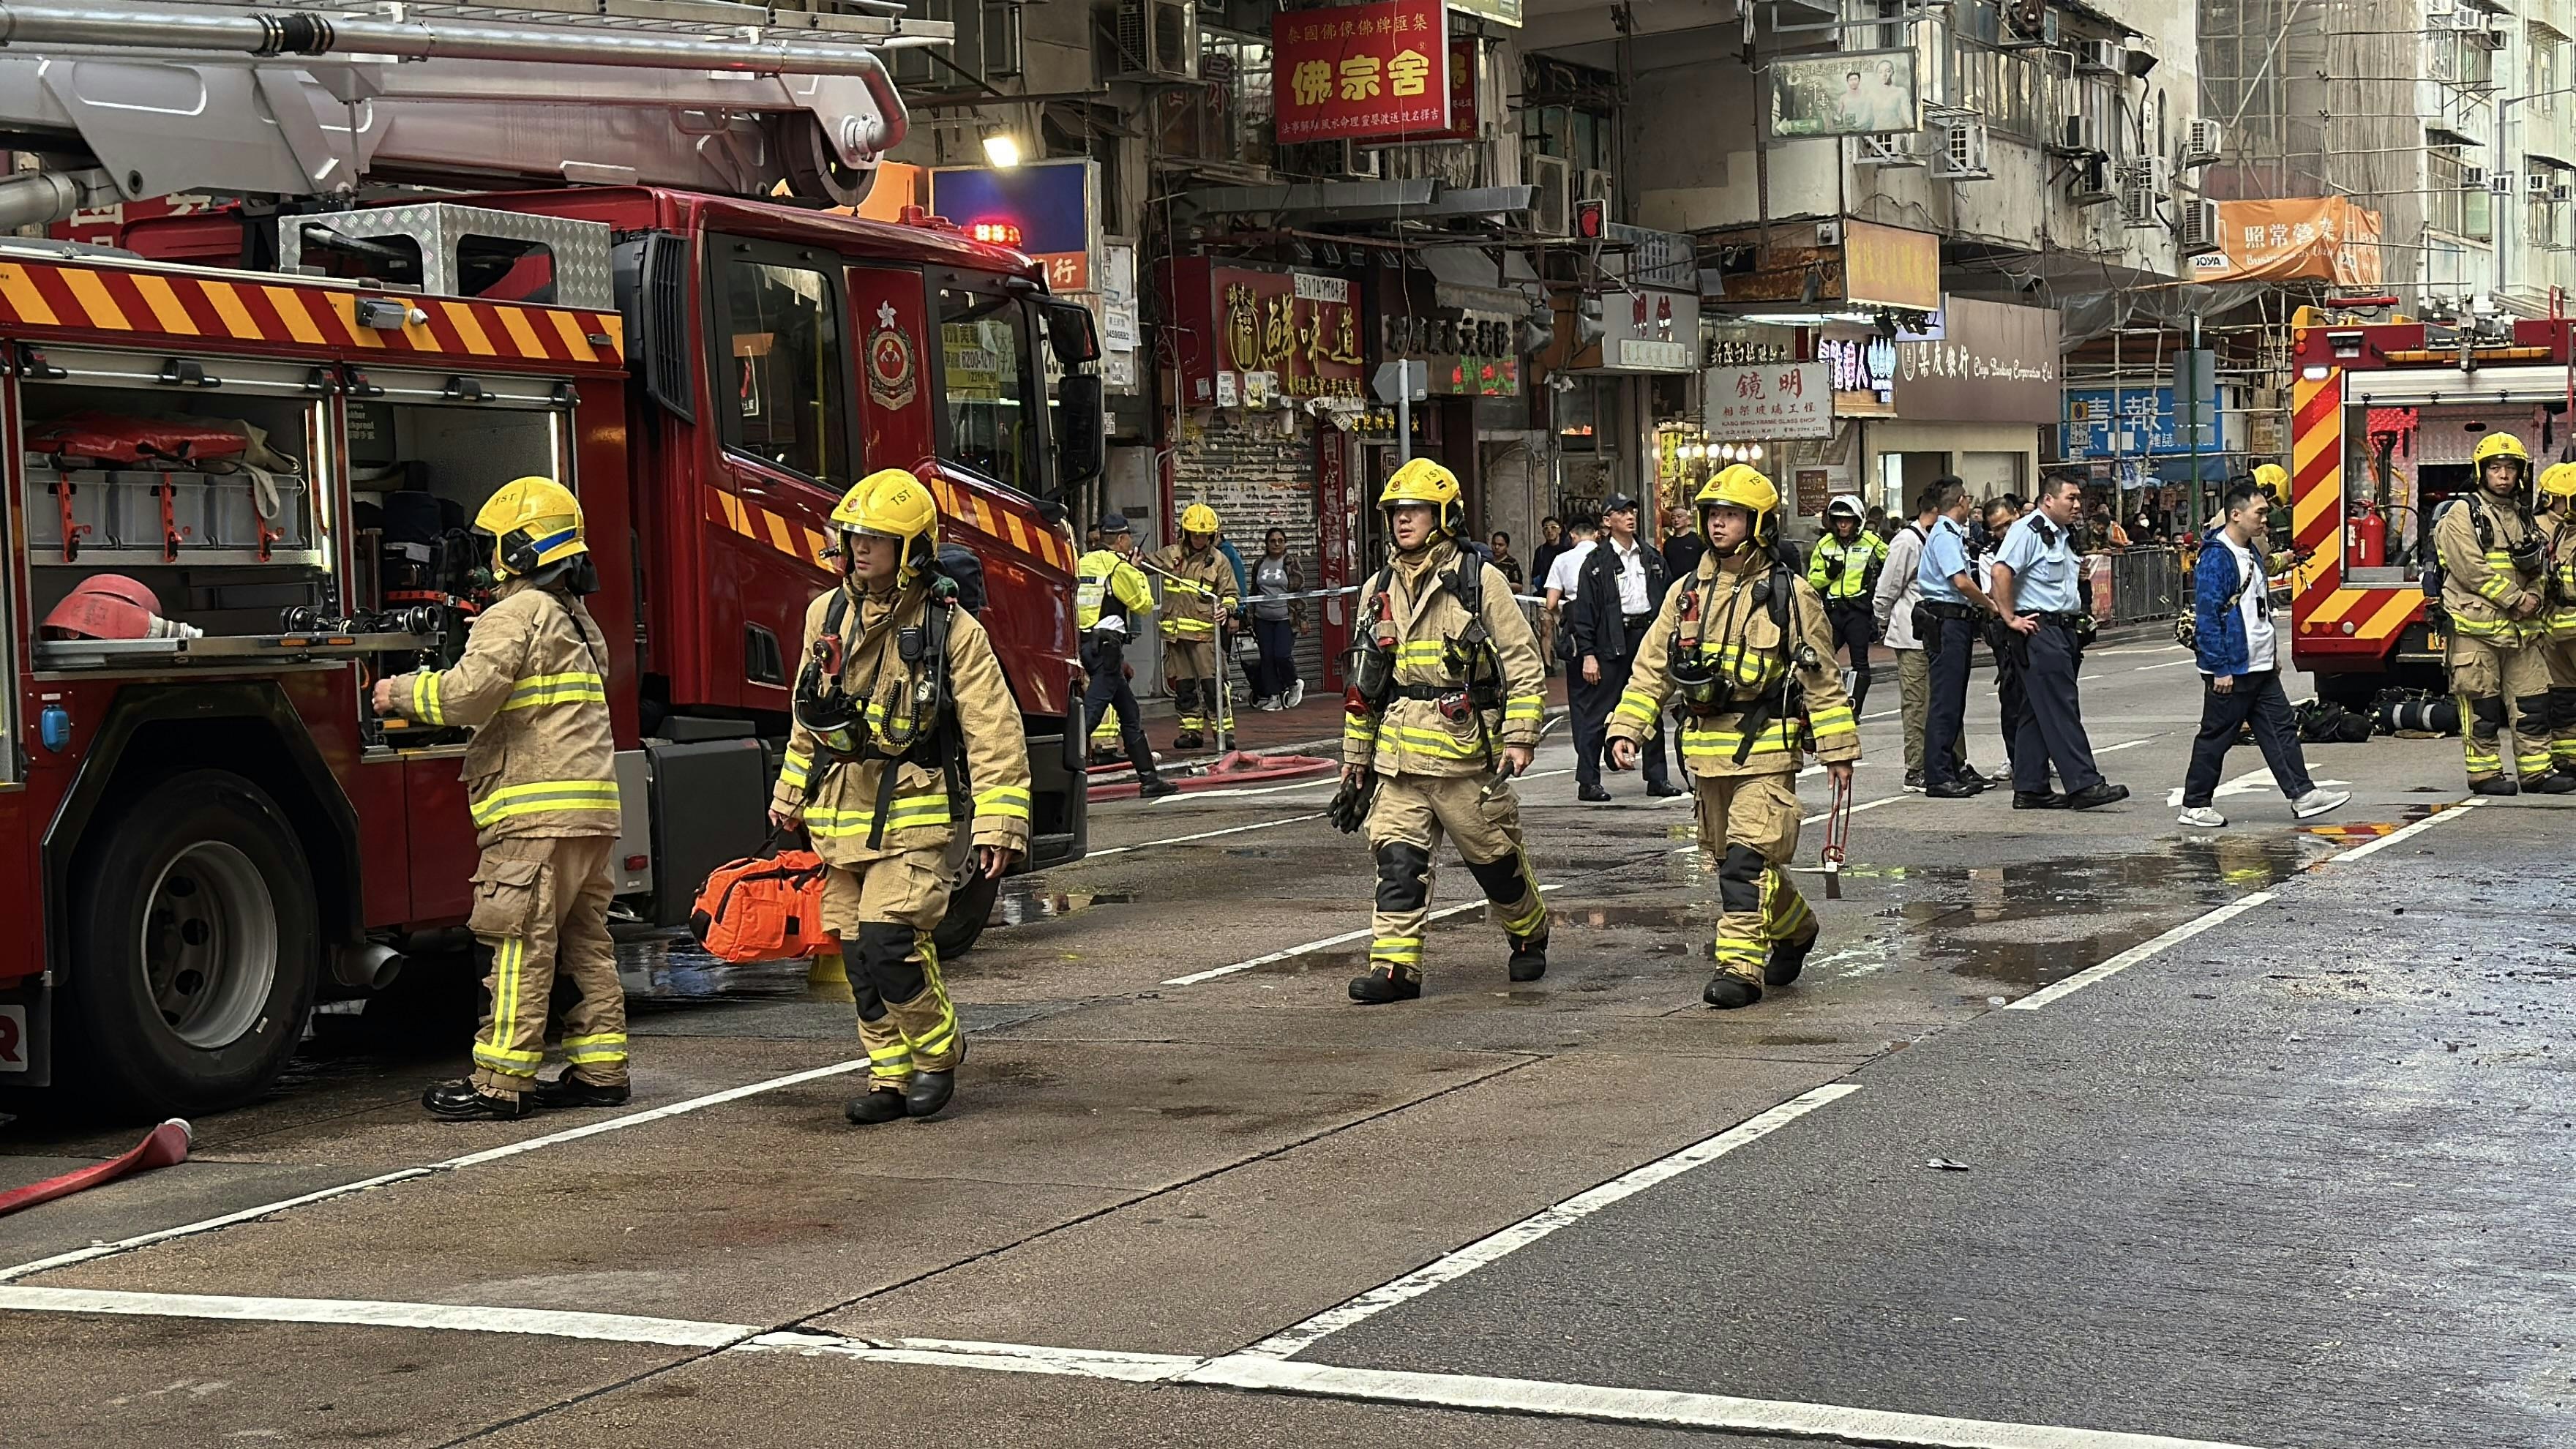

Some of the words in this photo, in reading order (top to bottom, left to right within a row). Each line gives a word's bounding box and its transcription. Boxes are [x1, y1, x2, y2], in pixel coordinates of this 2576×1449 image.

[1291, 49, 1430, 106] 佛宗舍
[2244, 216, 2337, 250] 照常營業
[1261, 293, 1363, 394] 鮮味道
[1918, 341, 1969, 381] 集友銀行
[1991, 358, 2012, 381] Banking
[2013, 359, 2040, 381] Corporation
[1735, 367, 1802, 400] 鏡明
[495, 493, 517, 506] TST
[891, 489, 911, 506] TST
